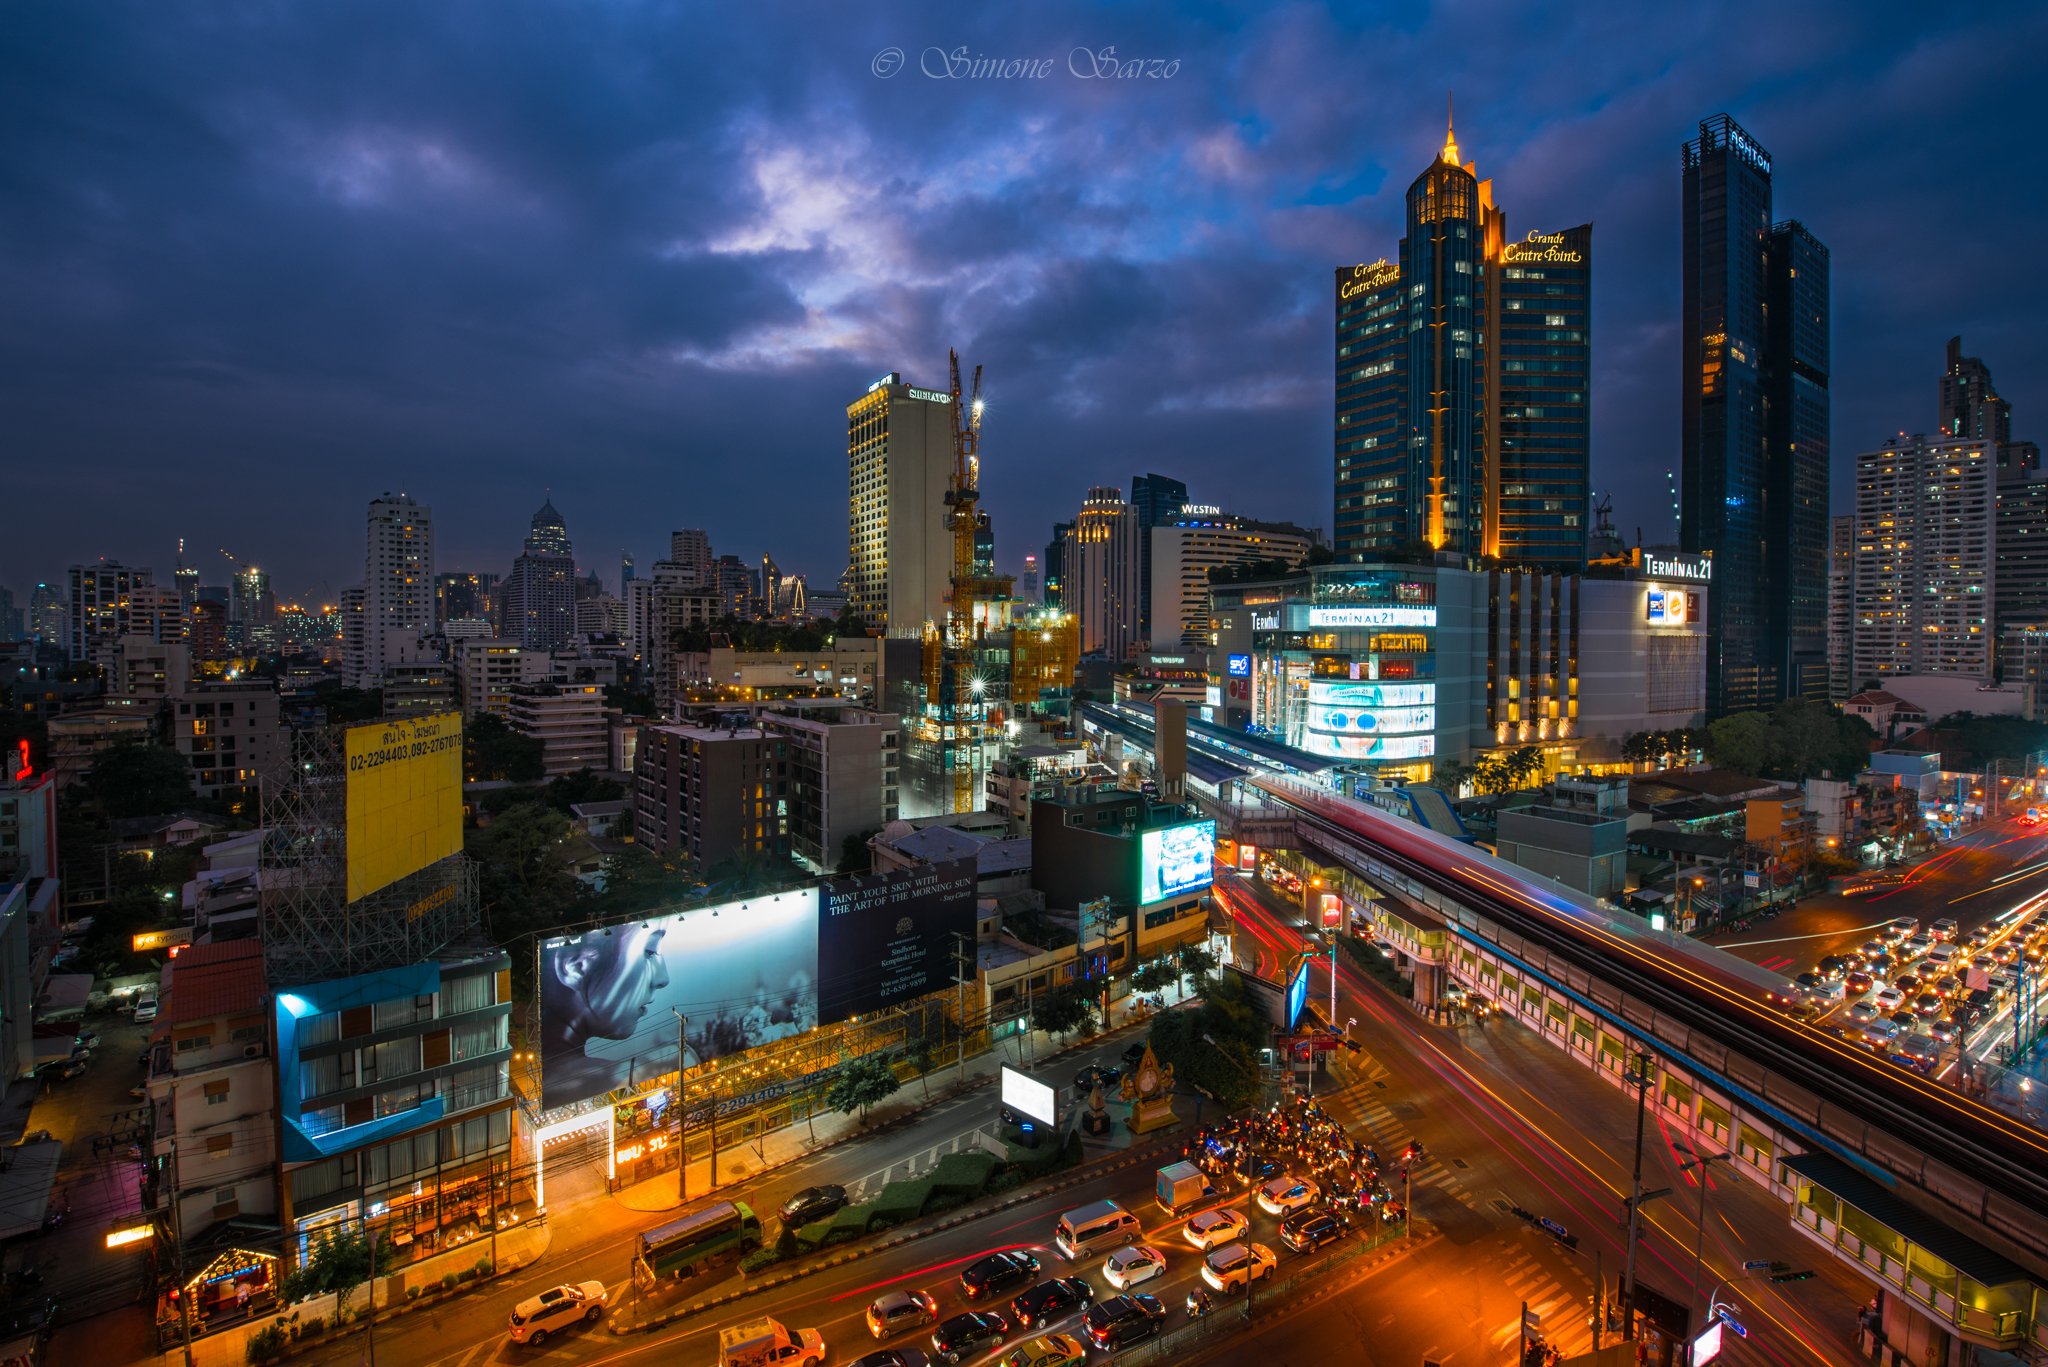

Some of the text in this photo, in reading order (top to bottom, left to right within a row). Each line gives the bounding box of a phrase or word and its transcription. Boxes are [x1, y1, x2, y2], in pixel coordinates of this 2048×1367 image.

[1731, 130, 1770, 173] ASHTON
[1528, 230, 1565, 245] Grande
[1504, 244, 1582, 262] Centre Point
[1354, 257, 1386, 278] Grande
[1341, 266, 1400, 299] Centre Point
[1181, 504, 1220, 515] WESTIN
[829, 875, 938, 906] PAINT YOUR SKIN WITH
[829, 877, 972, 916] THE ART OF THE MORNING SUN
[881, 947, 927, 968] Kempinski Hotel
[891, 944, 917, 956] Sindhorn
[880, 976, 927, 997] 02-650-9899
[881, 980, 892, 988] Visit
[899, 975, 911, 983] Sales
